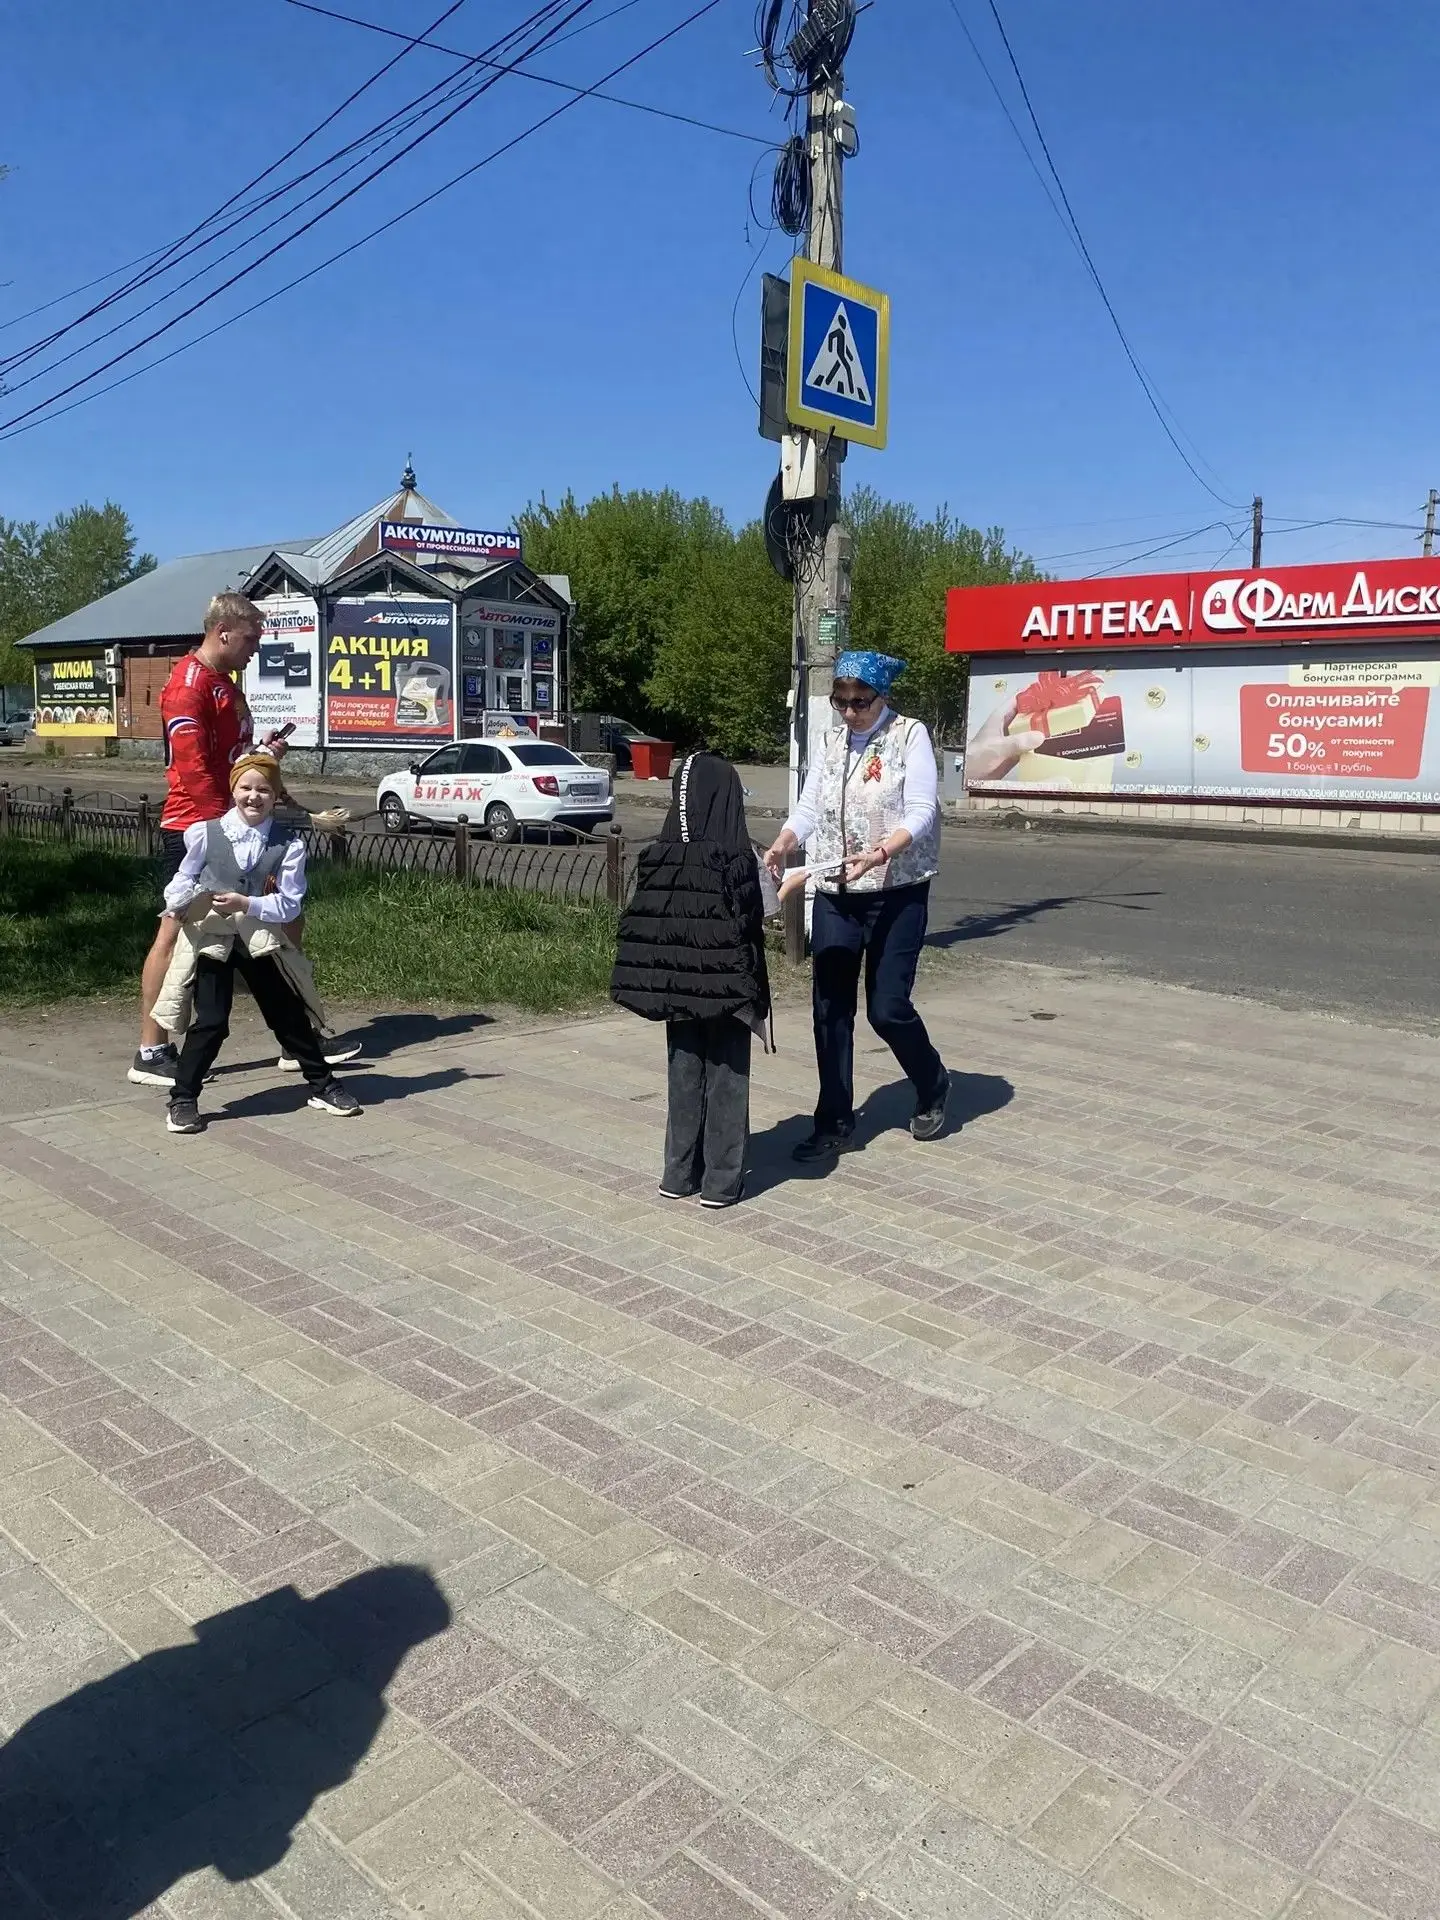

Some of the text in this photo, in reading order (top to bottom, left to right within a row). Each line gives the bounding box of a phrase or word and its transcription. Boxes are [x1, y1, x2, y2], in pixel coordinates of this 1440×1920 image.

[384, 525, 520, 549] АККУМУЛЯТОРЫ
[426, 543, 490, 555] ПРОФЕССИОНАЛОВ
[1021, 598, 1183, 638] АПТЕКА
[1341, 572, 1440, 616] ДИСК
[328, 636, 429, 660] АКЦИЯ
[53, 660, 93, 679] ХИЛОЛА
[328, 659, 391, 691] 4+1
[1324, 662, 1397, 672] Партнерская
[1303, 673, 1422, 683] бонусная программа
[250, 693, 292, 701] ДИАГНОСТИКА
[330, 700, 346, 709] При
[1266, 691, 1400, 708] Оплачивайте
[252, 716, 281, 724] СТАНОВКА
[1279, 713, 1384, 730] бонусами!
[1089, 744, 1107, 752] КАРТА
[1266, 733, 1394, 758] 50% от стоимости
[1343, 750, 1383, 758] покупки
[1287, 762, 1292, 770] 1
[1293, 761, 1323, 774] бонус
[1334, 762, 1339, 771] 1
[1341, 762, 1372, 773] рубль
[680, 770, 690, 790] LOVE
[414, 786, 484, 801] ВИРАЖ
[679, 790, 687, 811] LOVE
[1422, 791, 1432, 801] НА
[679, 811, 688, 832] LOVE
